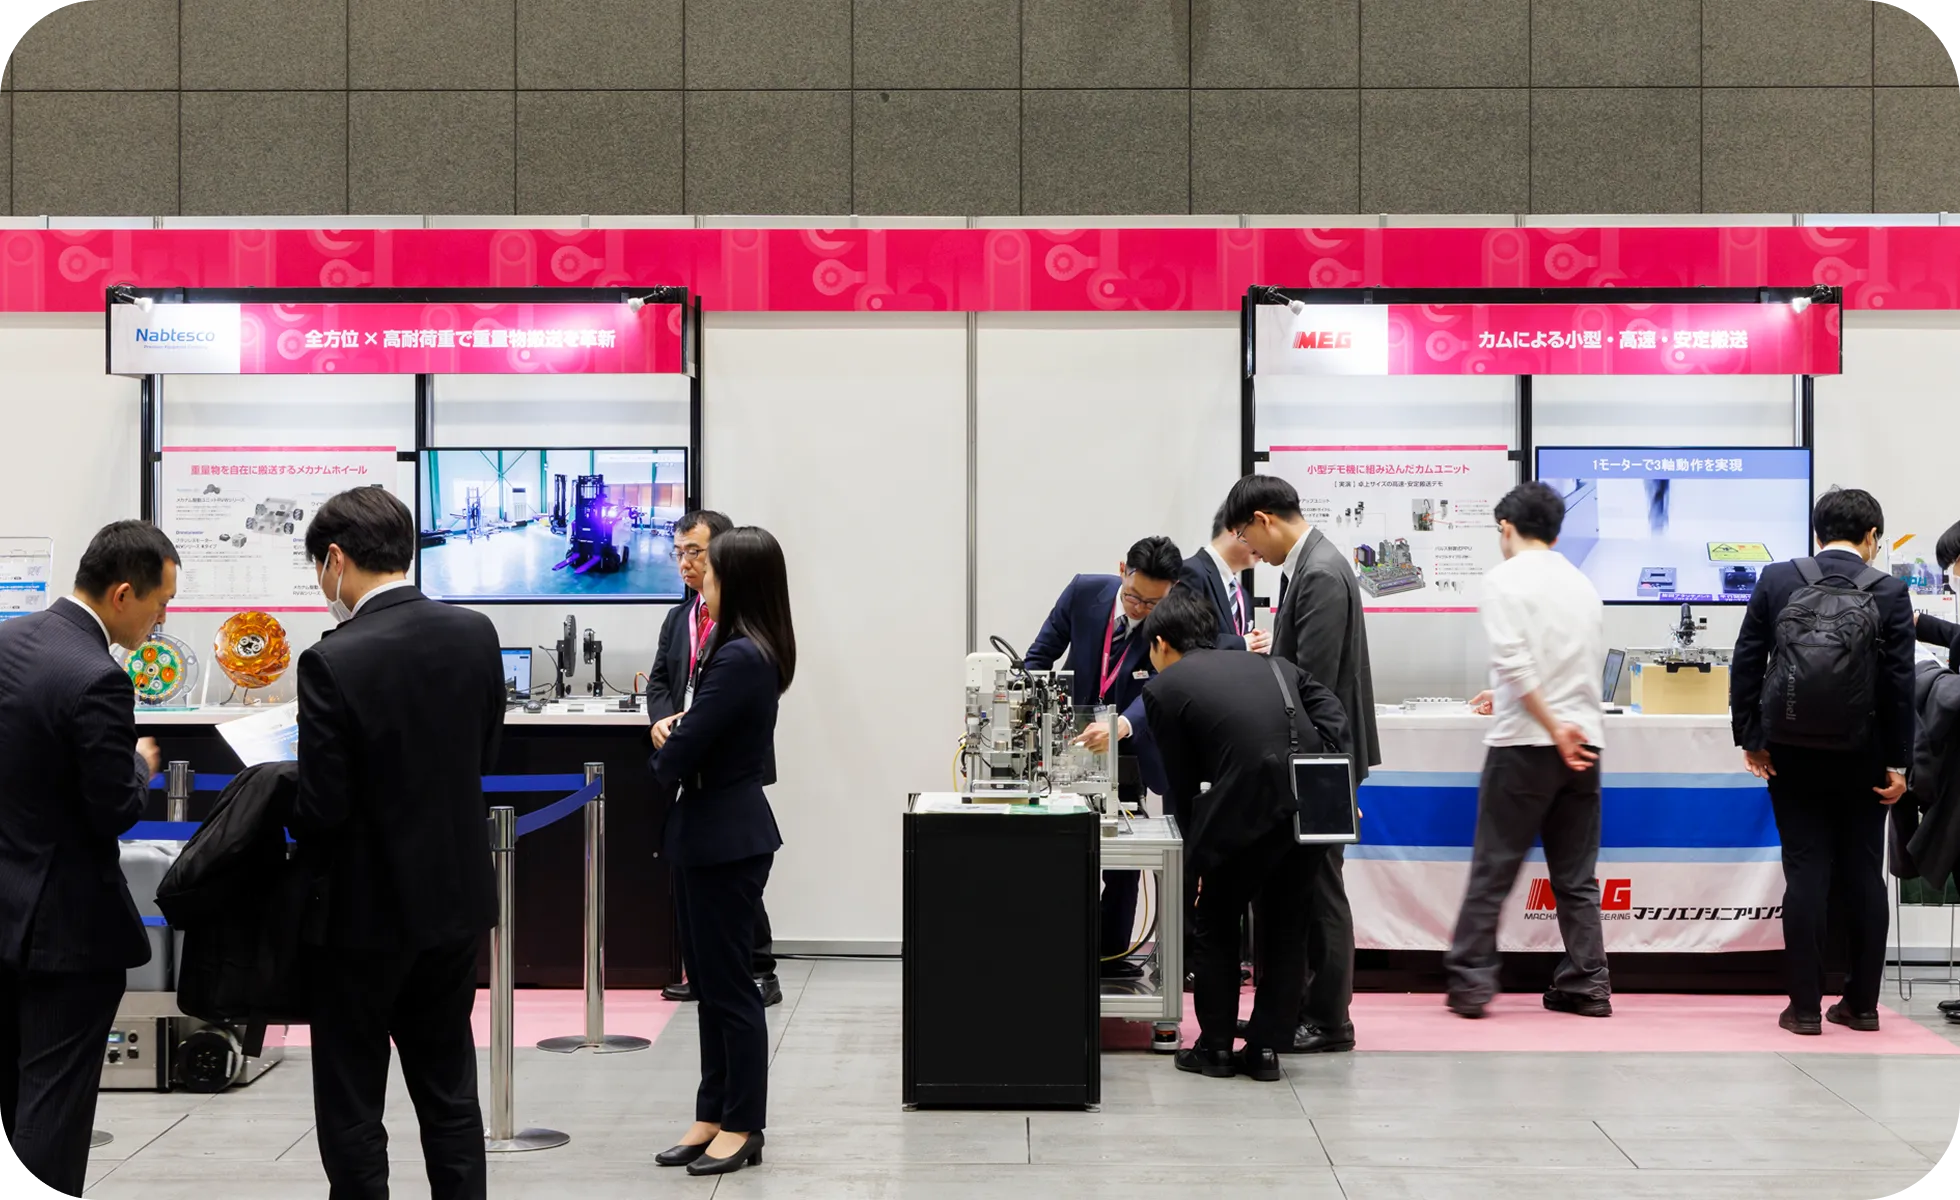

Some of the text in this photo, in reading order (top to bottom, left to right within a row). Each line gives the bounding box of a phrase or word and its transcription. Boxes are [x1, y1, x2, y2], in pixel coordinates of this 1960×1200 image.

[135, 328, 215, 342] Nabtesco
[1292, 331, 1352, 349] MEG
[1478, 330, 1748, 349] カムによる小型・高速・安定搬送
[191, 465, 368, 476] 重量物を自在に搬送するメカナムホイール
[1307, 464, 1471, 475] 小型デモ機に組み込んだカムユニット
[1592, 458, 1743, 472] 1モーターで3軸動作を実現
[1525, 878, 1631, 910] MG
[1524, 912, 1558, 920] MACHIN
